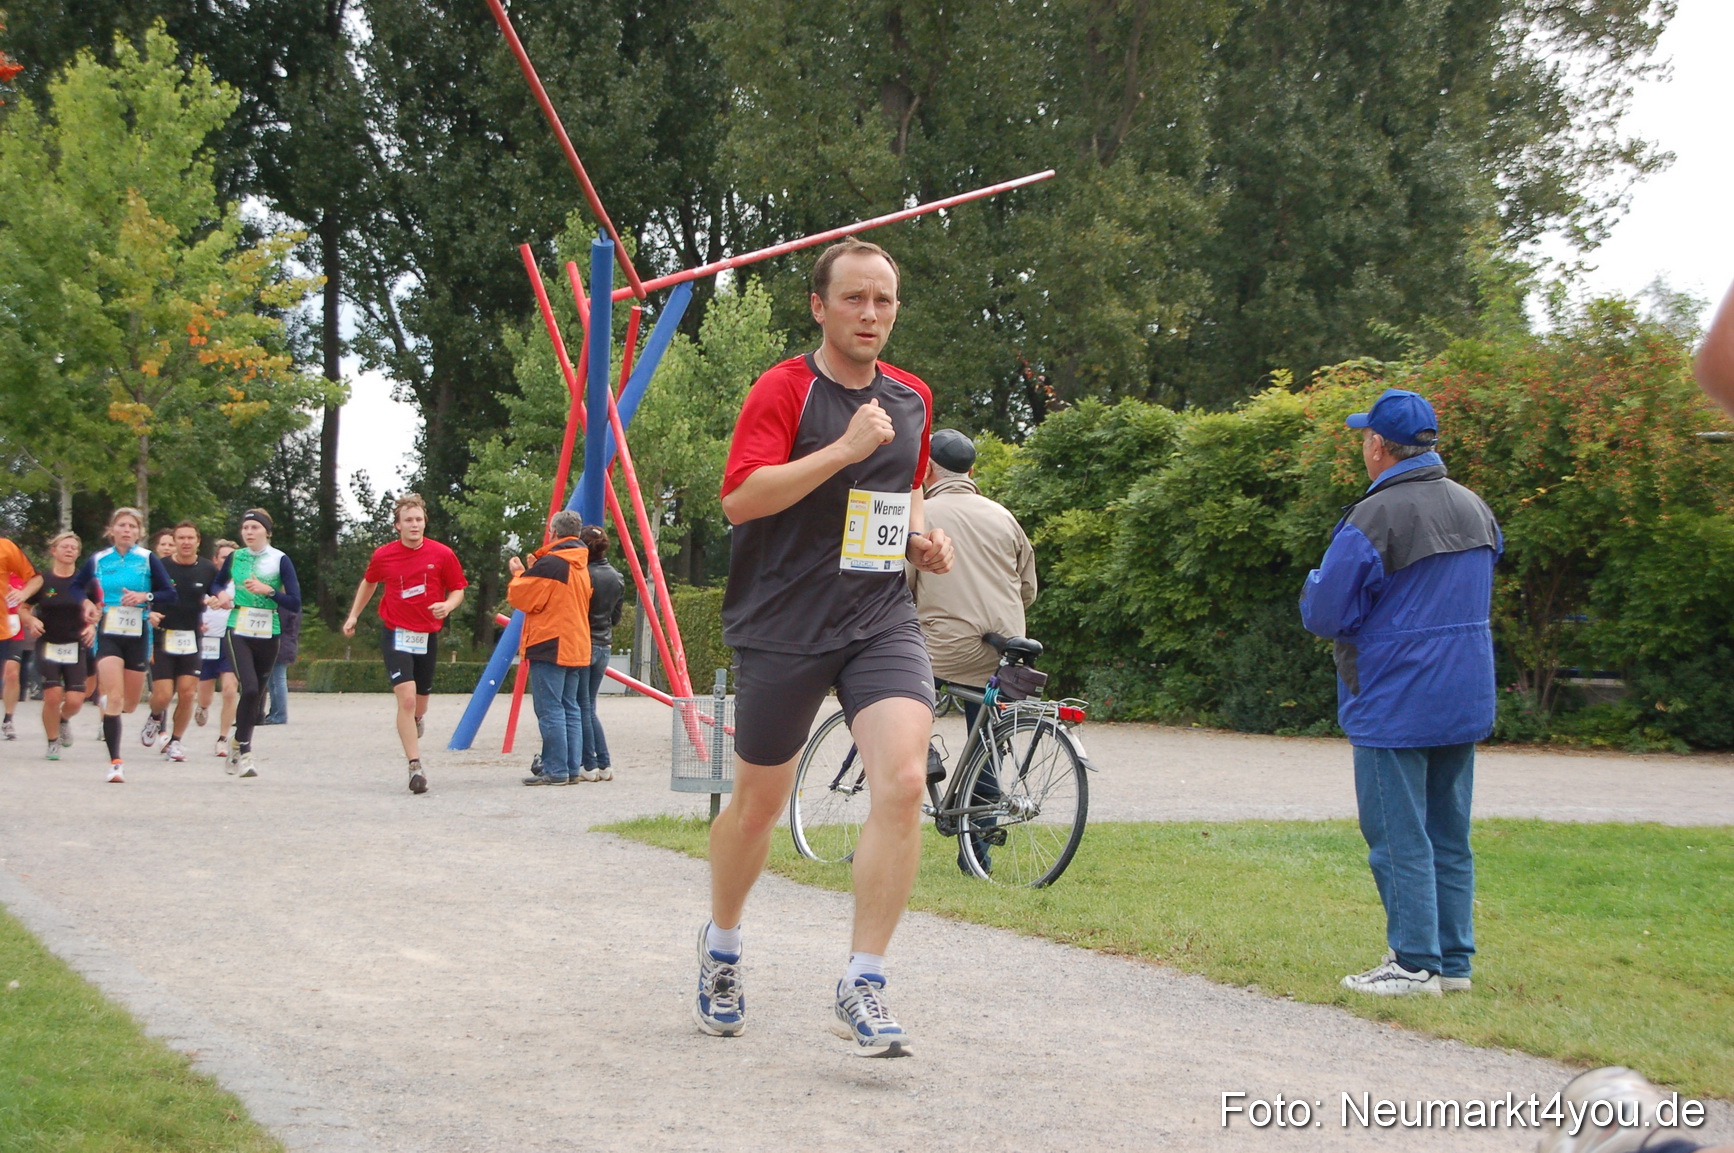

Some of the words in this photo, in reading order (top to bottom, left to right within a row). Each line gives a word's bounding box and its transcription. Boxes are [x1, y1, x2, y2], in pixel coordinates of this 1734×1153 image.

[873, 499, 905, 515] Werner
[849, 520, 856, 532] C
[877, 524, 905, 546] 921
[118, 617, 137, 627] 716
[250, 619, 267, 629] 717
[405, 635, 425, 645] 2366
